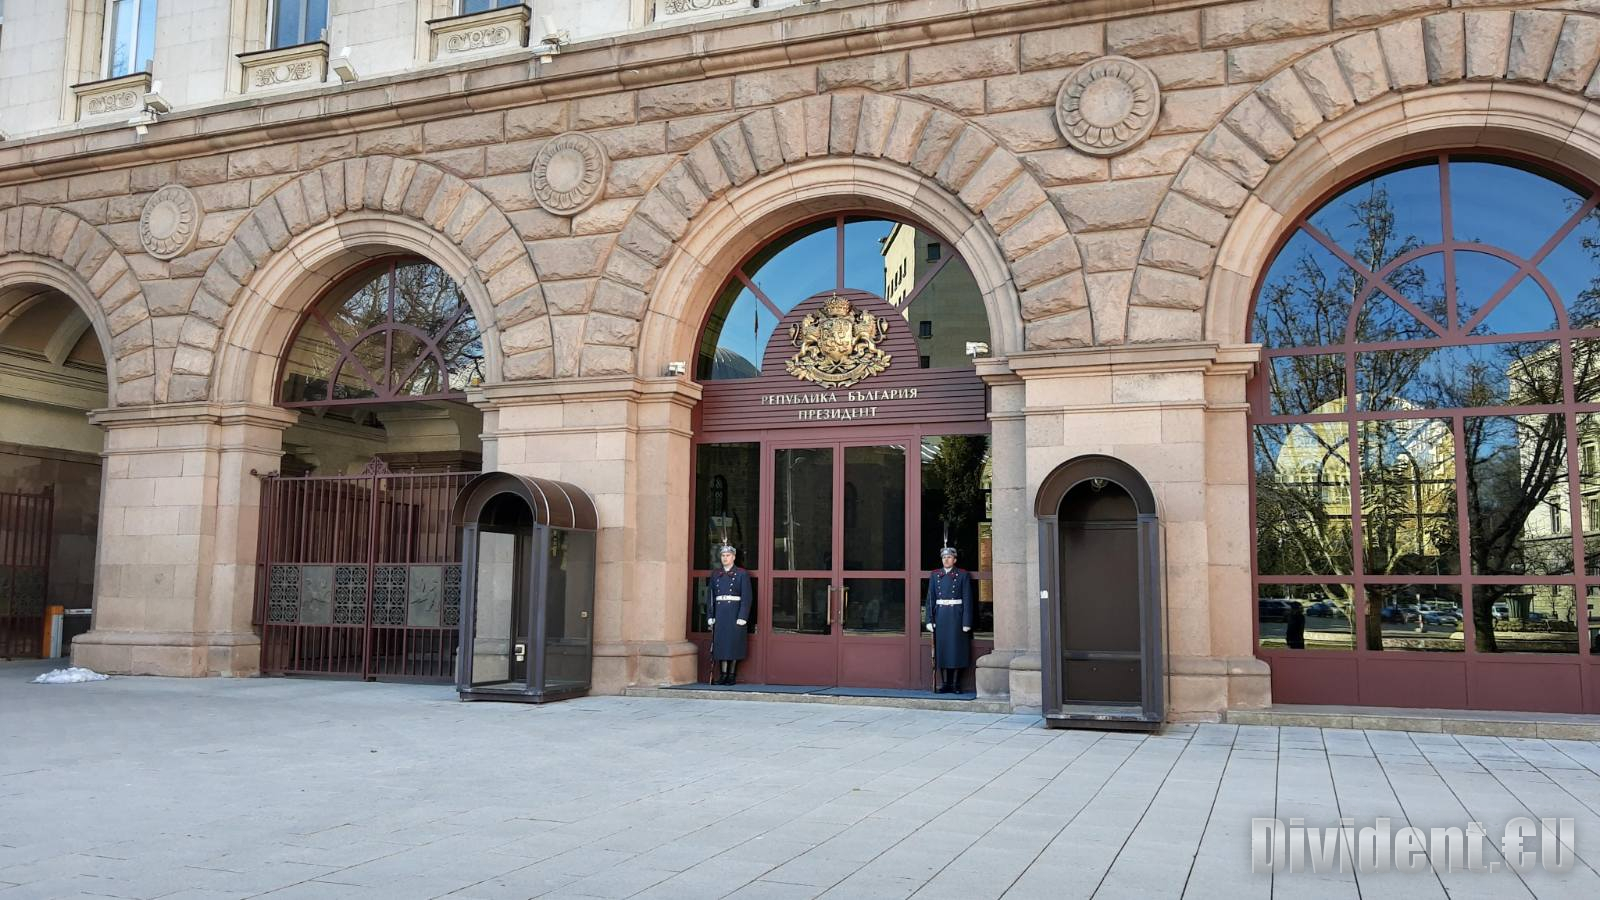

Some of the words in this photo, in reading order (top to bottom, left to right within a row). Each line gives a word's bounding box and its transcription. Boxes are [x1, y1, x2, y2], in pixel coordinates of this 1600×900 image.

[761, 391, 837, 405] РЕПУБЛИКА
[848, 388, 918, 402] БЪЛГАРИЯ
[798, 406, 878, 421] ПРЕЗИДЕНТ
